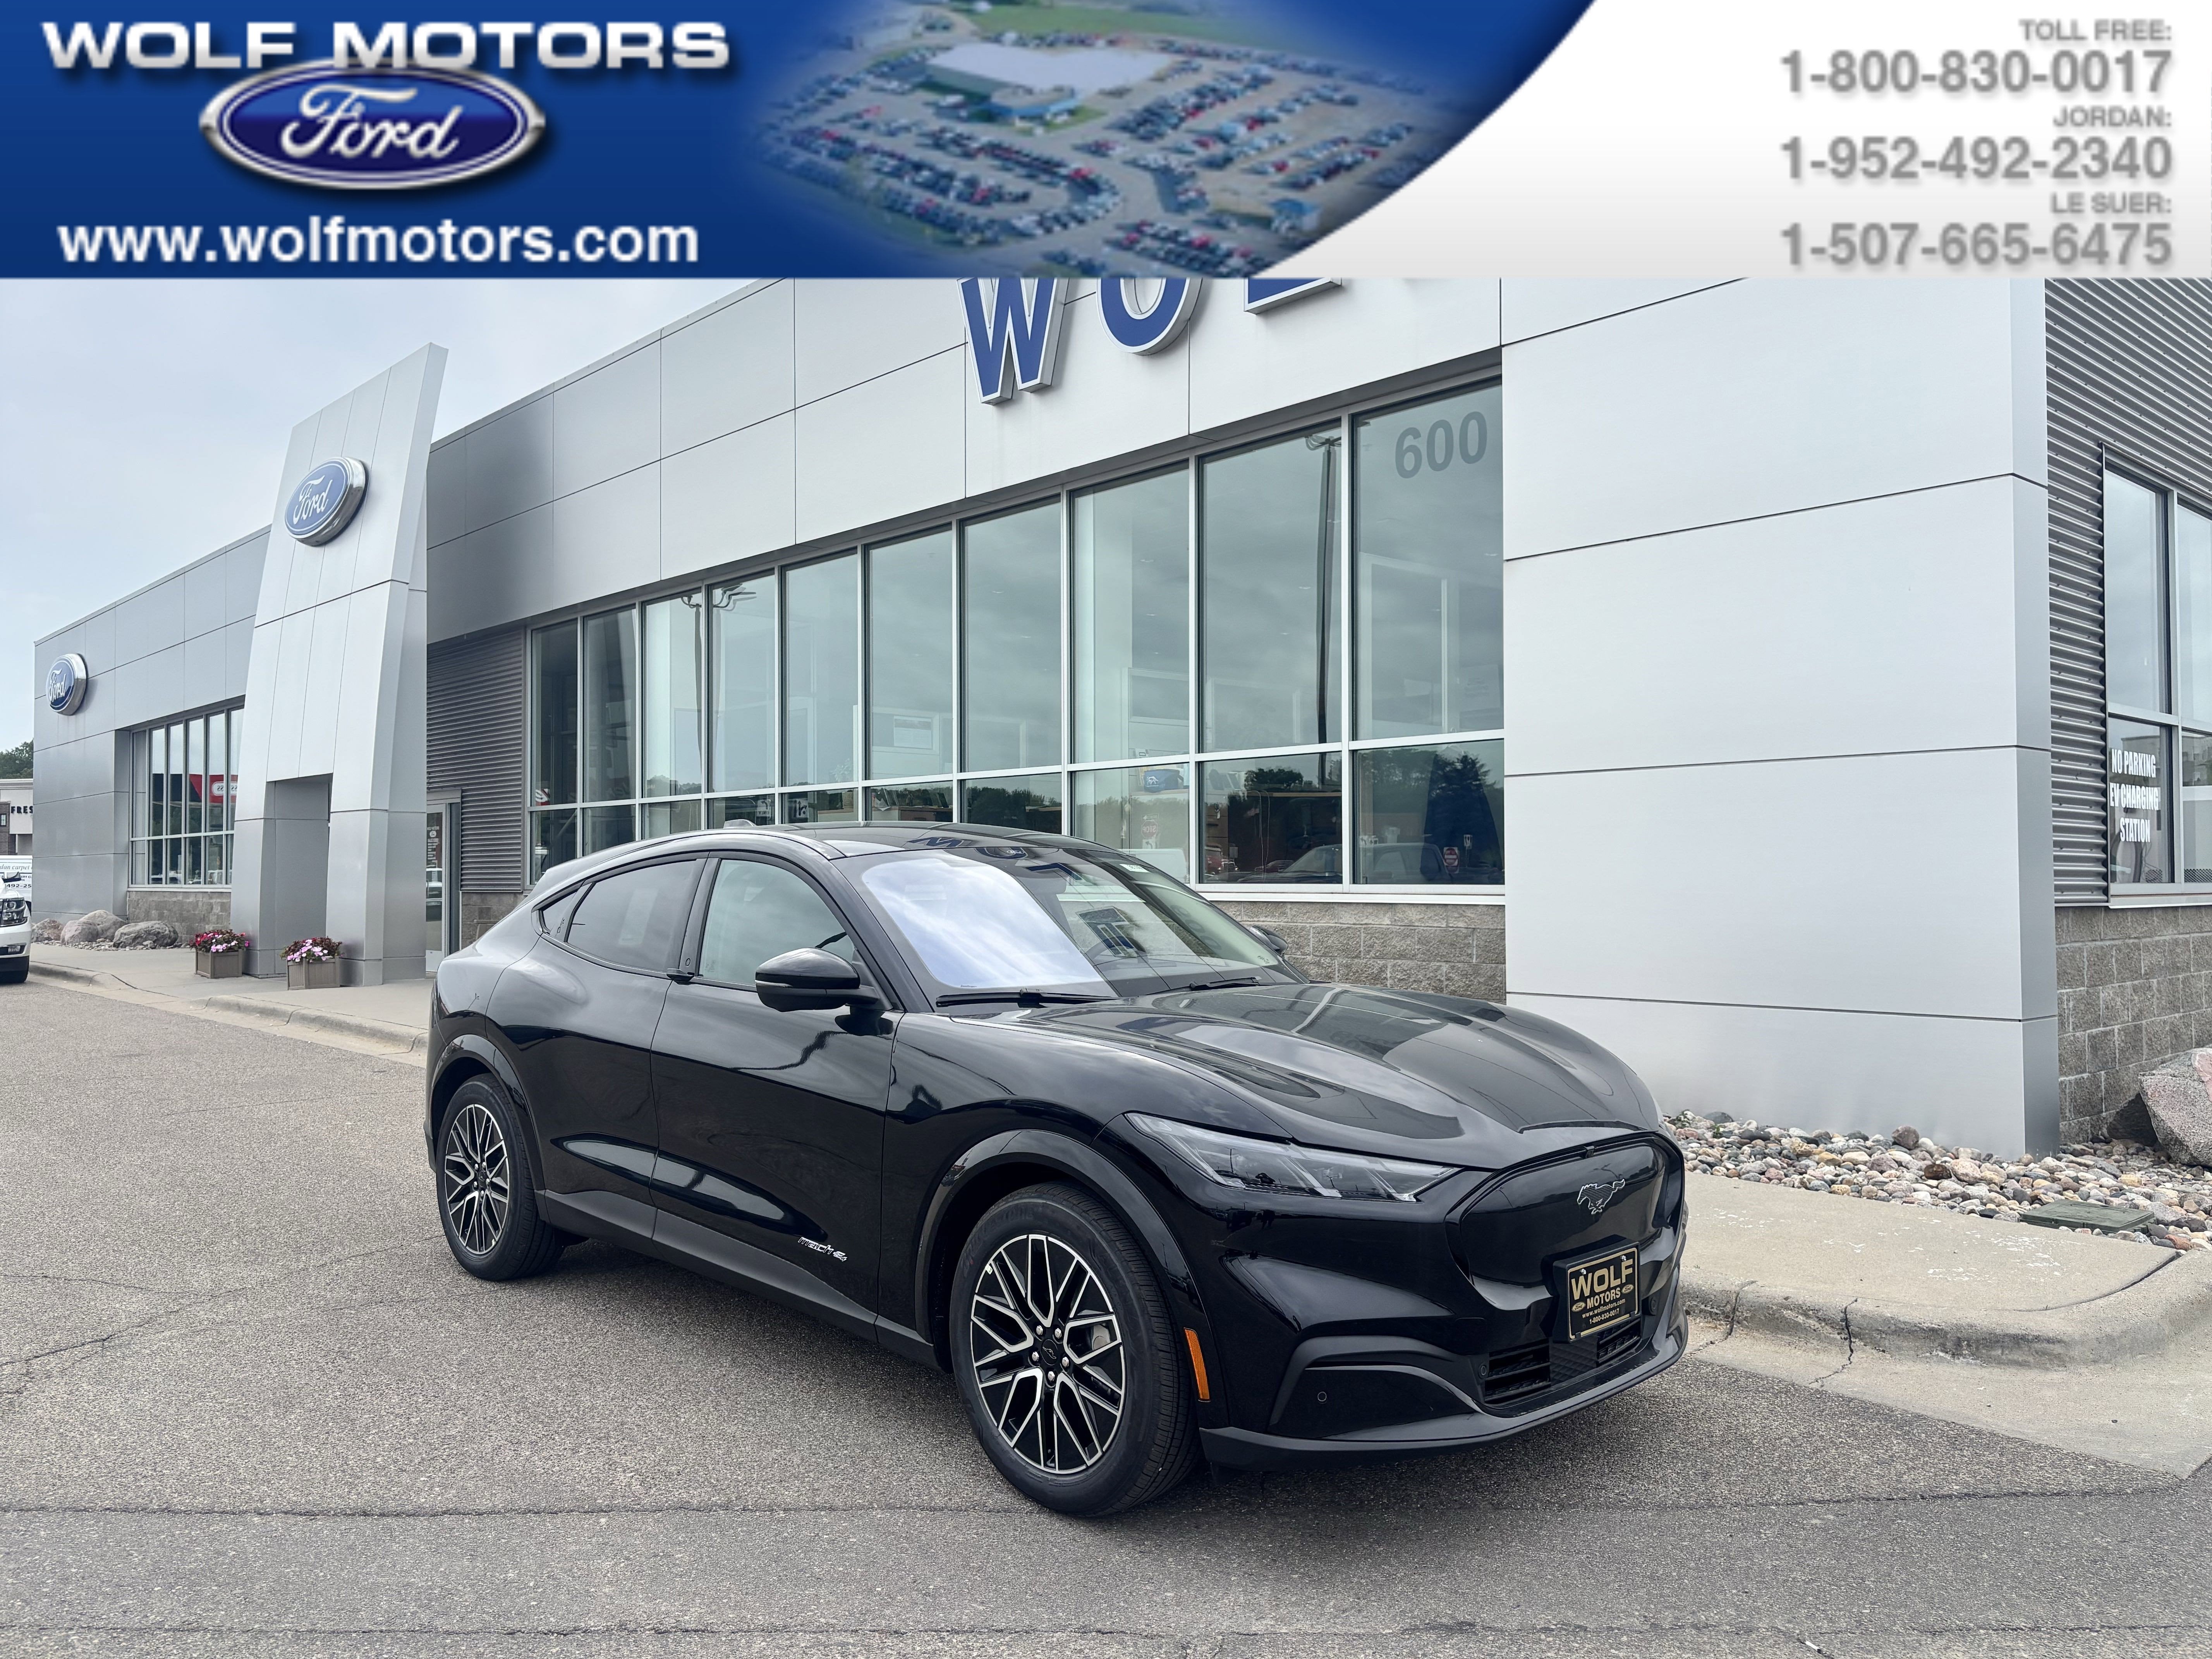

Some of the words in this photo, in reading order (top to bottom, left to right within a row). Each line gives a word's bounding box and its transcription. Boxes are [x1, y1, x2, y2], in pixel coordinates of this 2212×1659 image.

[957, 277, 1342, 405] WO
[1395, 411, 1487, 479] 600
[293, 475, 333, 524] Ford
[49, 668, 66, 704] Ford
[2112, 748, 2122, 774] NO
[2124, 750, 2156, 778] PARKING
[2109, 782, 2119, 807] EV
[2121, 783, 2159, 811] CHARGING
[2120, 817, 2150, 843] STATION
[1571, 1259, 1633, 1300] WOLF
[1582, 1298, 1626, 1318] www.wolfmotors.com
[1587, 1287, 1621, 1309] MOTORS
[1589, 1308, 1619, 1324] 1-800-830-0017
